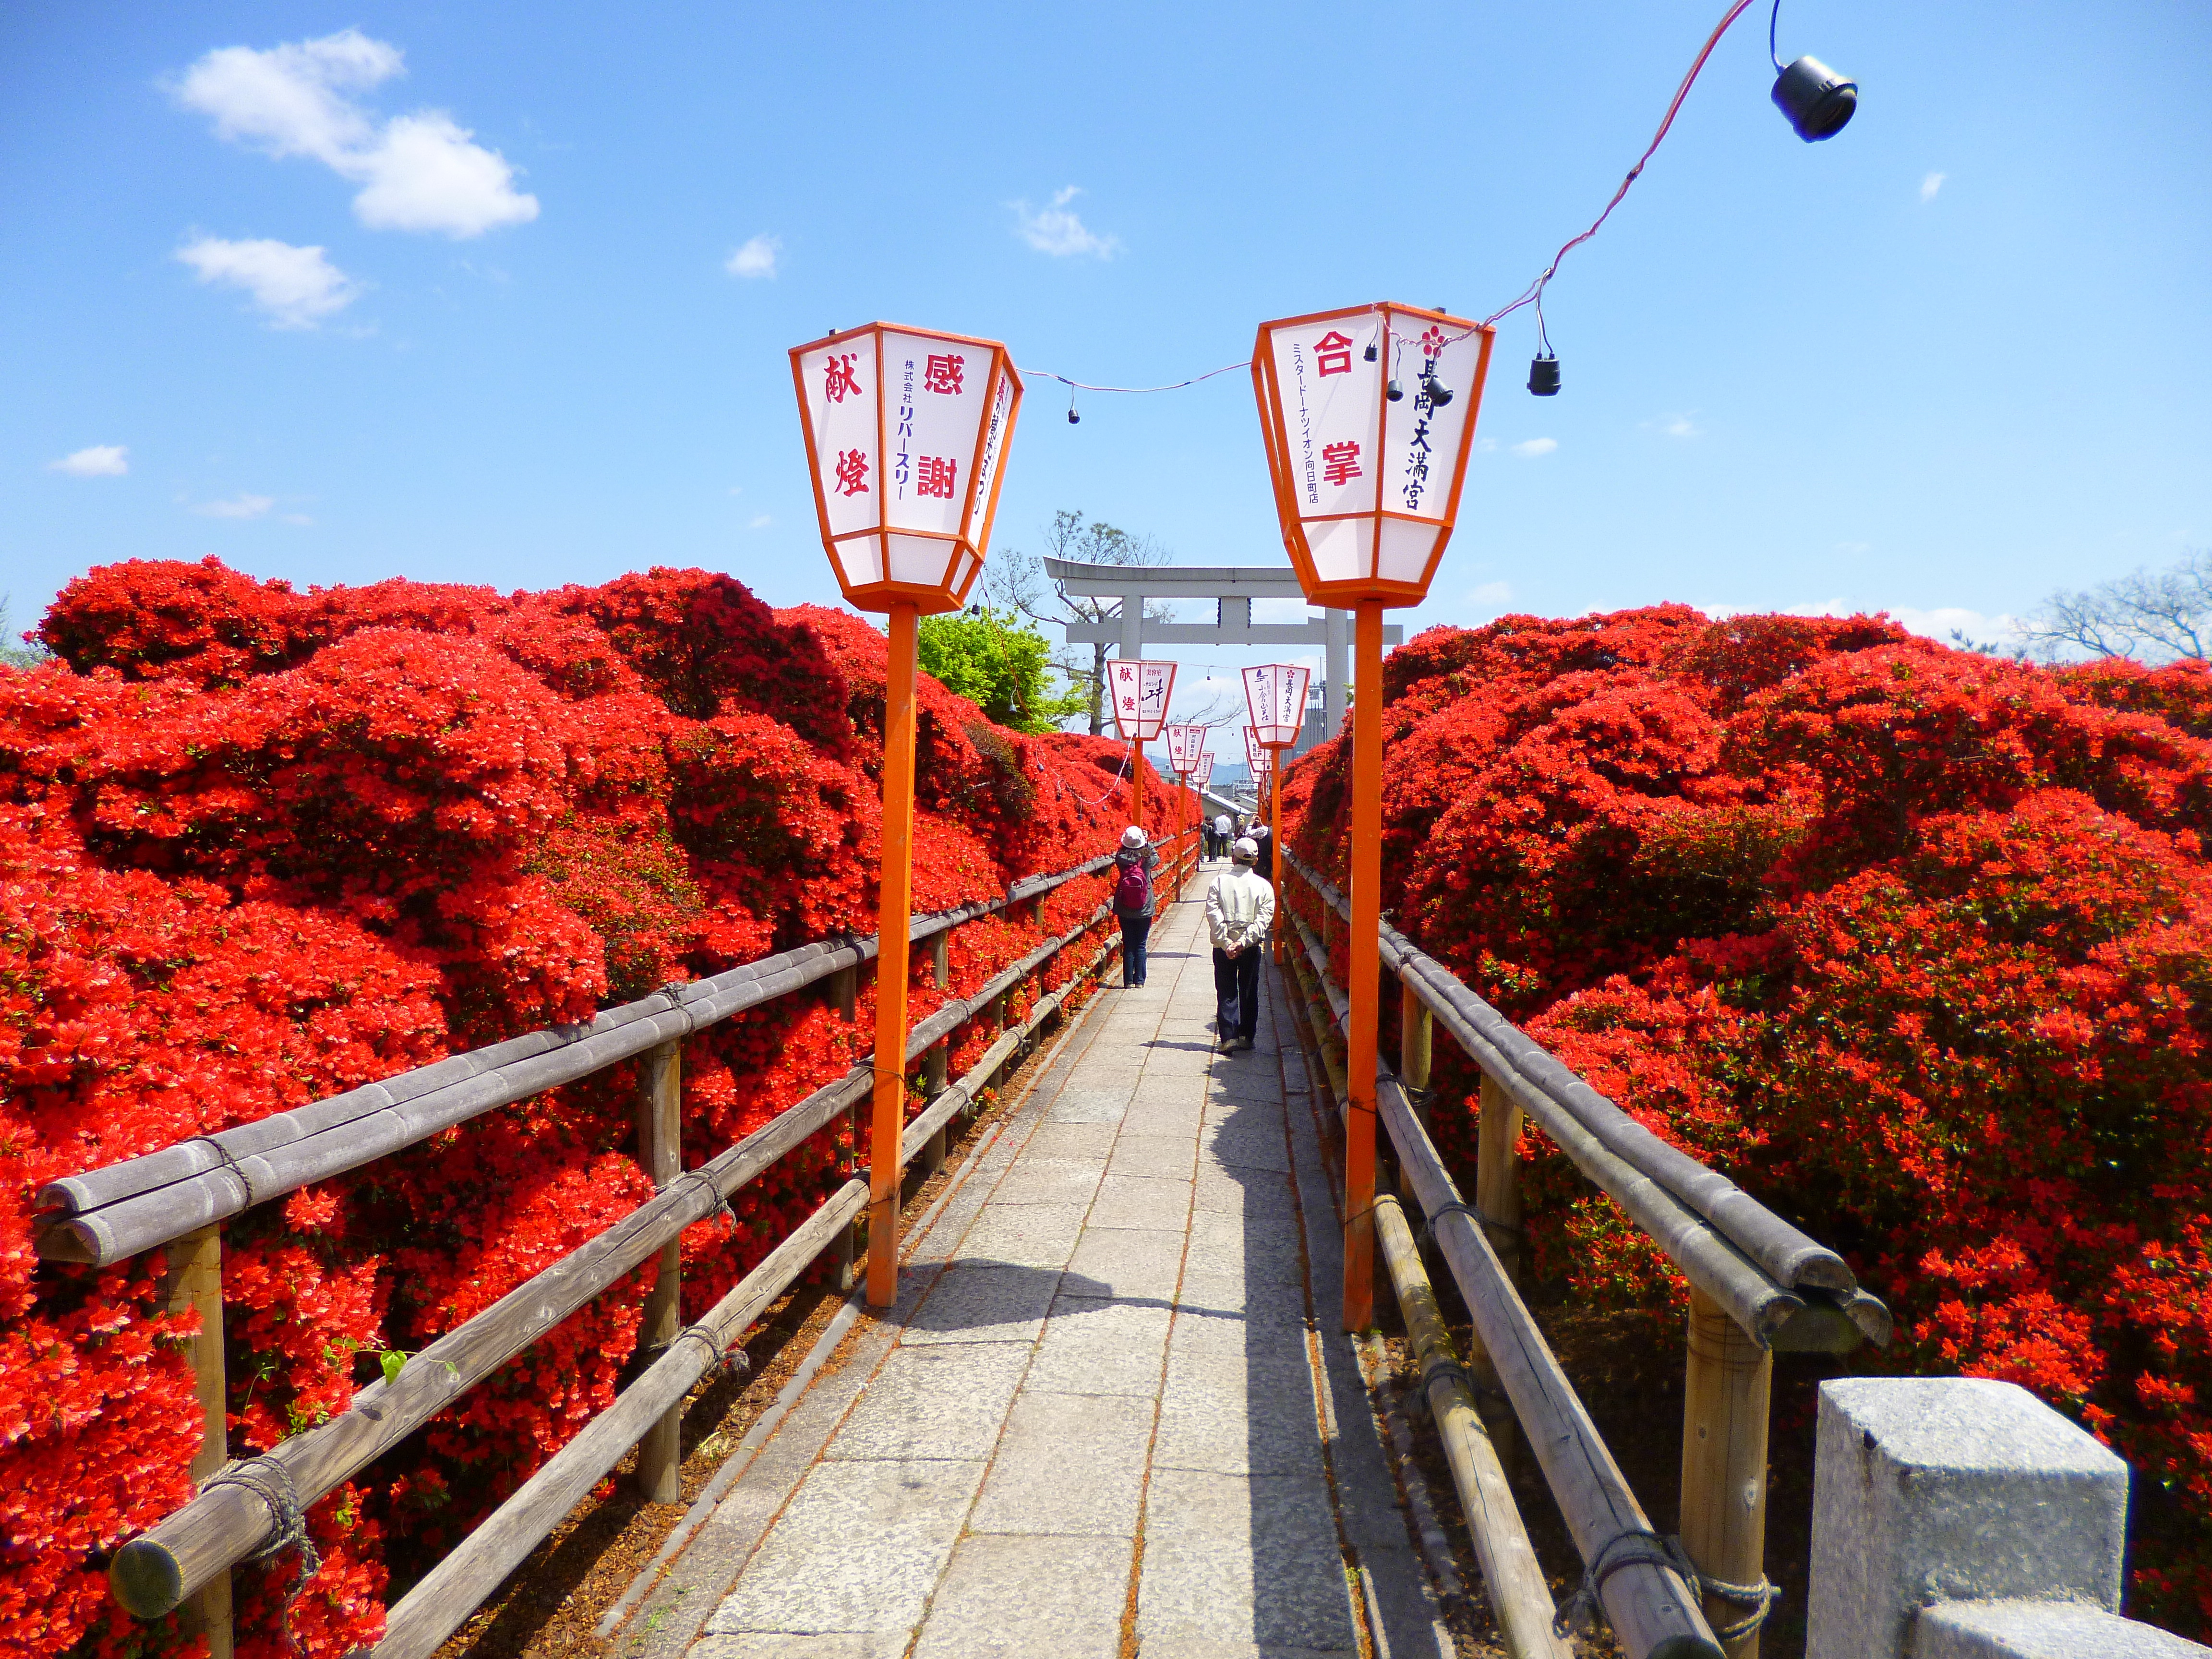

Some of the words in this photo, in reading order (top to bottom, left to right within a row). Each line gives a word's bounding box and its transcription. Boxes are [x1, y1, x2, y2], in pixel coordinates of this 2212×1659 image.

[823, 353, 870, 497] 献燈
[895, 360, 914, 501] 株式会社リバースリー
[917, 354, 965, 499] 感謝
[1293, 343, 1319, 505] ミスタードーナツイオン向日町店
[1313, 331, 1363, 487] 合掌
